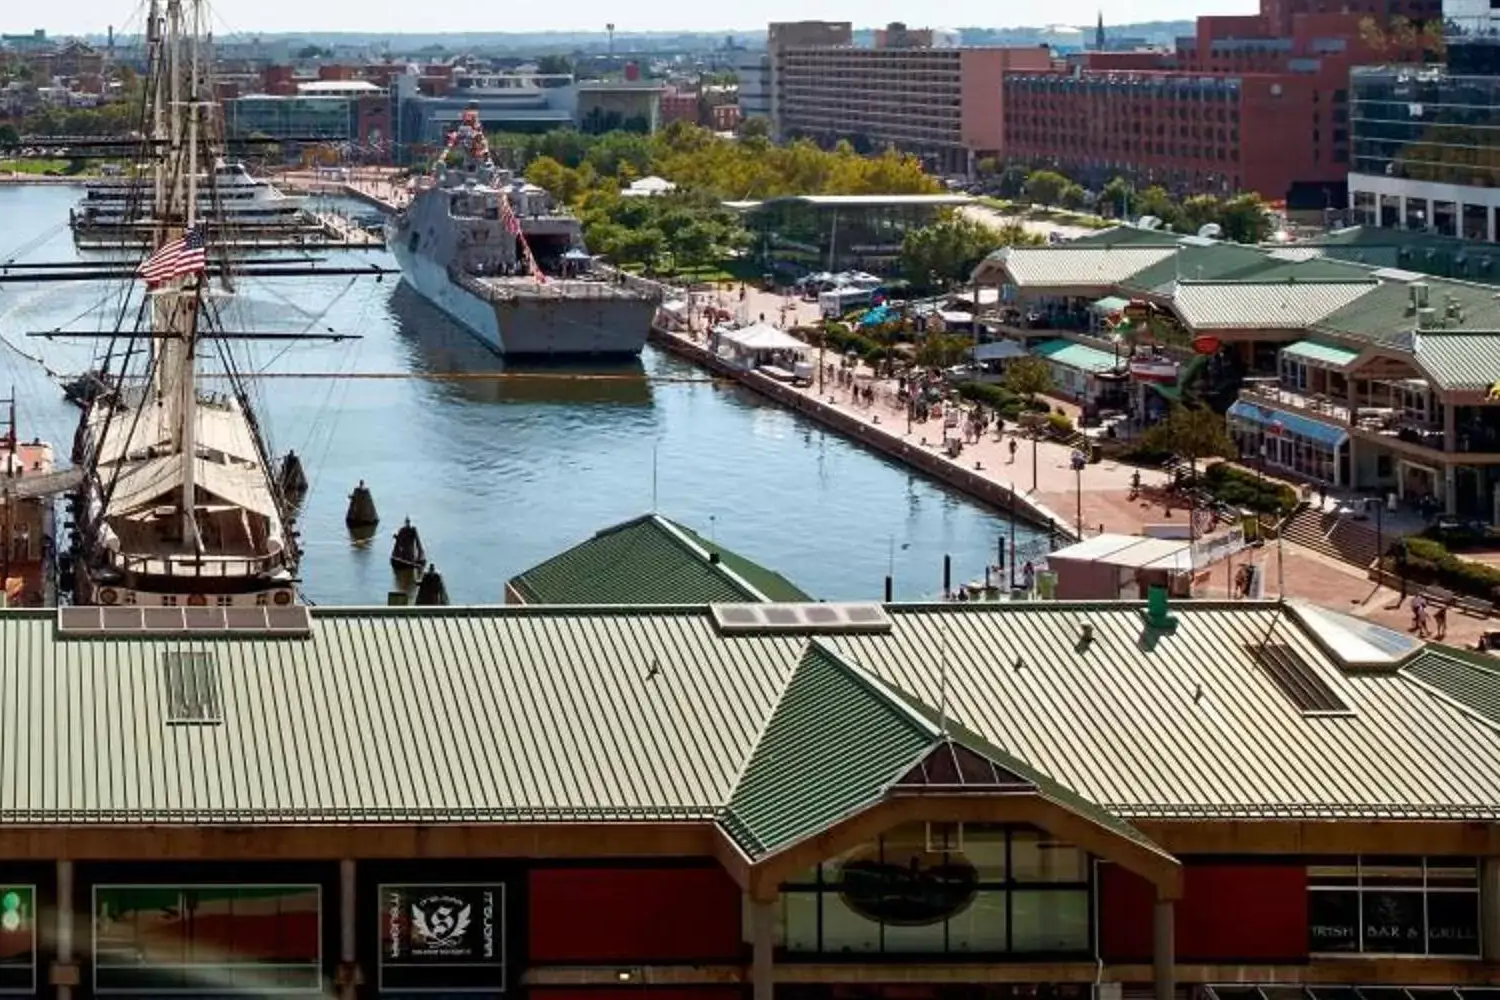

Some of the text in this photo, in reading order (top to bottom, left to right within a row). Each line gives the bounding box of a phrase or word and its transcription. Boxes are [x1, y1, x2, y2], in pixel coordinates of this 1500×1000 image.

[1313, 925, 1353, 937] IRISH
[1367, 926, 1400, 938] BAR
[1429, 927, 1476, 939] GRILL
